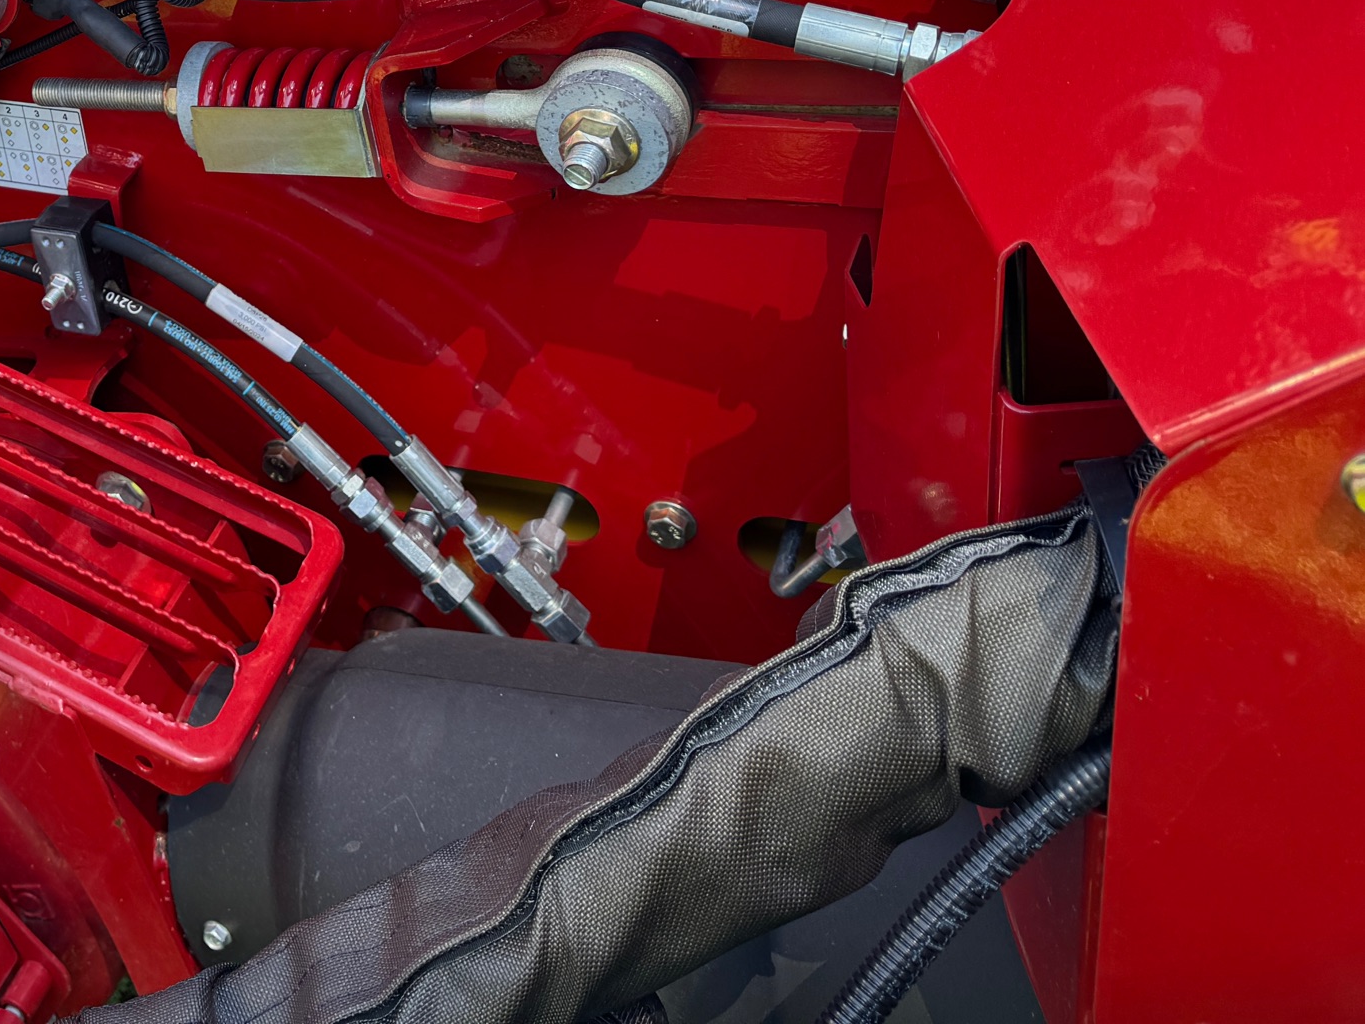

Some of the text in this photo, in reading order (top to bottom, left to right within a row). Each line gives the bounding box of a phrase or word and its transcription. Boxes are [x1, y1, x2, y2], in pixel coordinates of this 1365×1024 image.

[5, 106, 68, 121] 2 3 4
[106, 291, 129, 308] 210
[182, 337, 198, 351] ISO
[221, 368, 240, 384] SAE
